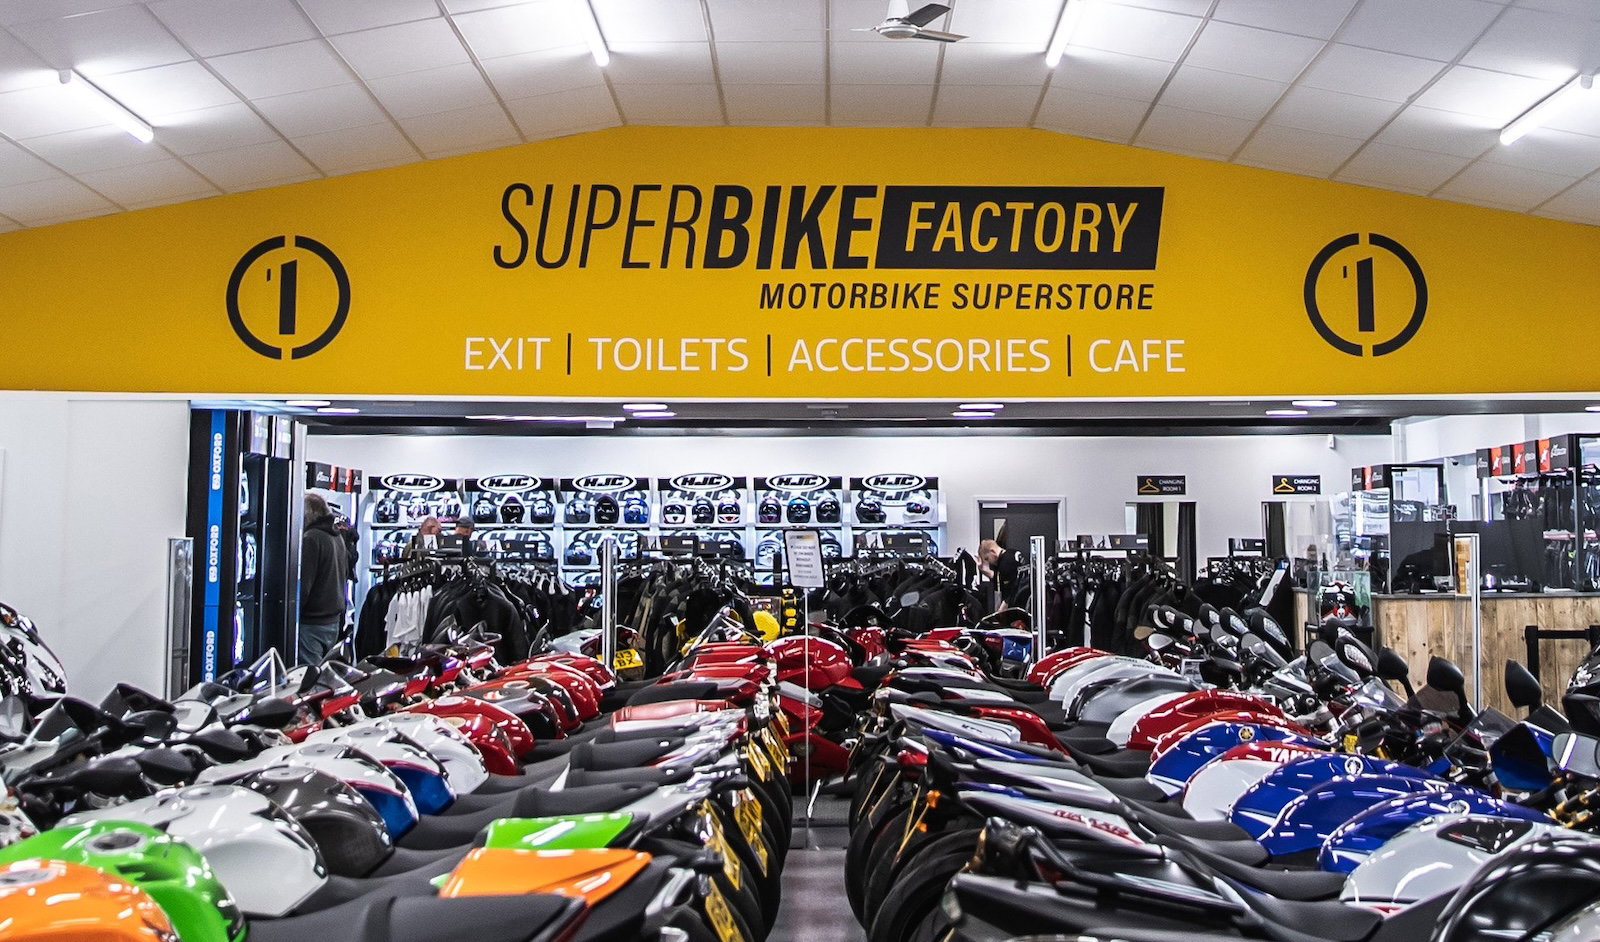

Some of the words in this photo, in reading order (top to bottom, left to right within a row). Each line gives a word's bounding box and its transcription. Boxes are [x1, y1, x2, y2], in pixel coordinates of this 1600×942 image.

[493, 183, 878, 270] SUPERBIKE
[905, 201, 1139, 253] FACTORY
[759, 283, 941, 309] MOTORBIKE
[952, 283, 1155, 310] SUPERSTORE
[464, 337, 551, 371] EXIT
[588, 337, 749, 372] TOILETS
[787, 338, 1051, 373] ACCESSORIES
[1088, 339, 1186, 373] CAFE
[213, 432, 222, 474] OXFORD
[391, 477, 434, 487] HJC
[488, 477, 529, 487] HJC
[584, 477, 625, 487] HJC
[681, 476, 723, 486] HJC
[776, 477, 819, 486] HJC
[873, 476, 915, 486] HJC
[209, 525, 219, 566] OXFORD
[205, 630, 215, 672] OXFORD
